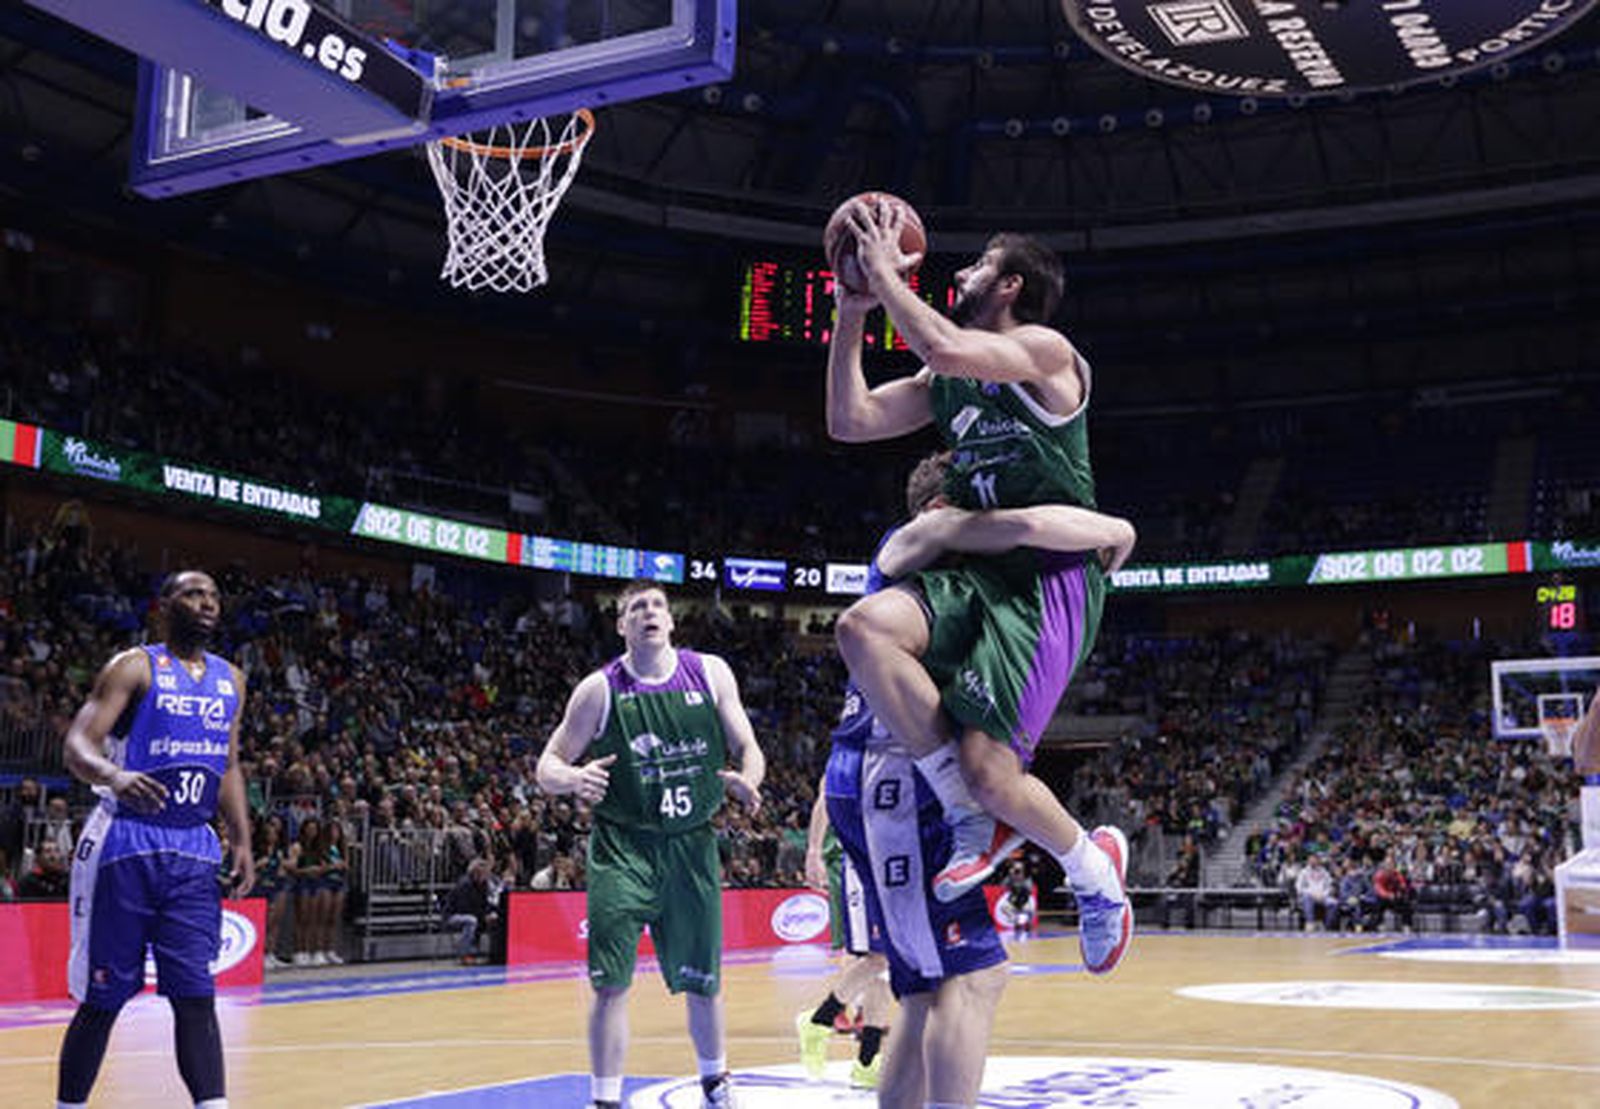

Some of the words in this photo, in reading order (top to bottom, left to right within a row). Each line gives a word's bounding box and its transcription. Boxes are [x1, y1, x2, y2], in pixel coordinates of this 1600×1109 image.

[163, 465, 216, 497] VENTA
[218, 476, 240, 502] DE
[242, 482, 321, 519] ENTRADAS
[436, 520, 460, 551] 02
[465, 527, 489, 558] 02
[690, 561, 717, 580] 34
[1412, 549, 1444, 574] 02
[1451, 547, 1483, 573] 02
[794, 567, 821, 587] 20
[1111, 568, 1160, 587] VENTA
[1163, 567, 1183, 584] DE
[1187, 563, 1270, 584] ENTRADAS
[1551, 602, 1576, 629] 18
[174, 771, 206, 805] 30
[660, 785, 693, 818] 45
